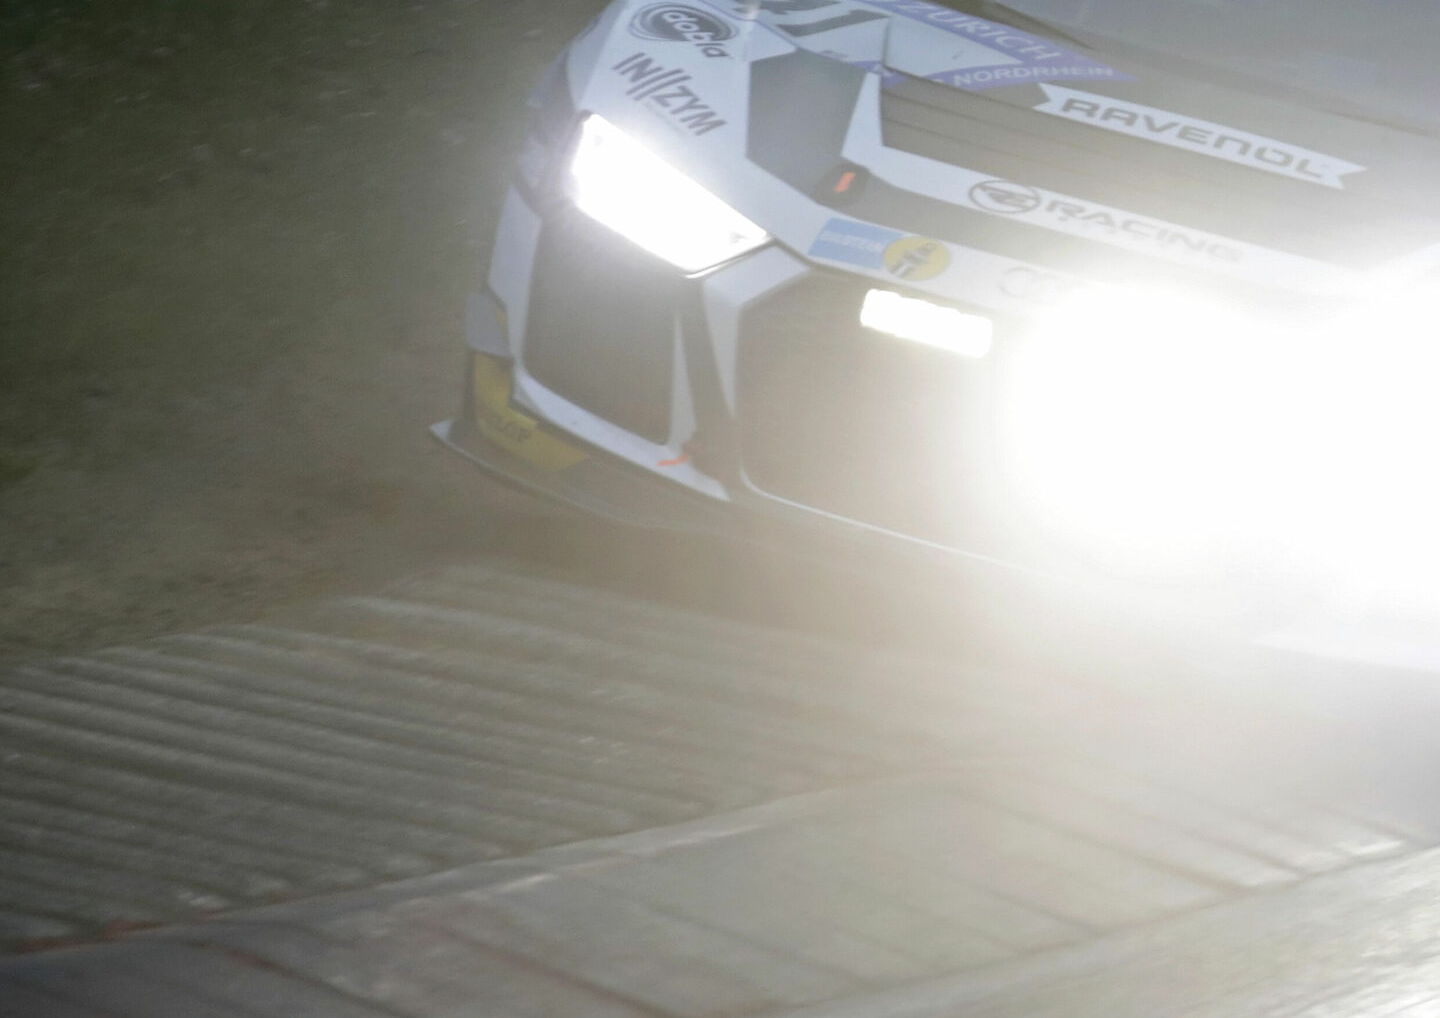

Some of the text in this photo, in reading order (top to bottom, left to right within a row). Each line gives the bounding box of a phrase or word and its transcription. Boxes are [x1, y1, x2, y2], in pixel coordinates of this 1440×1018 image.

[899, 1, 1062, 62] ZURICH
[951, 65, 1115, 88] NORDRHEIN
[1061, 97, 1328, 180] RAVENOL
[1045, 198, 1246, 264] RACING
